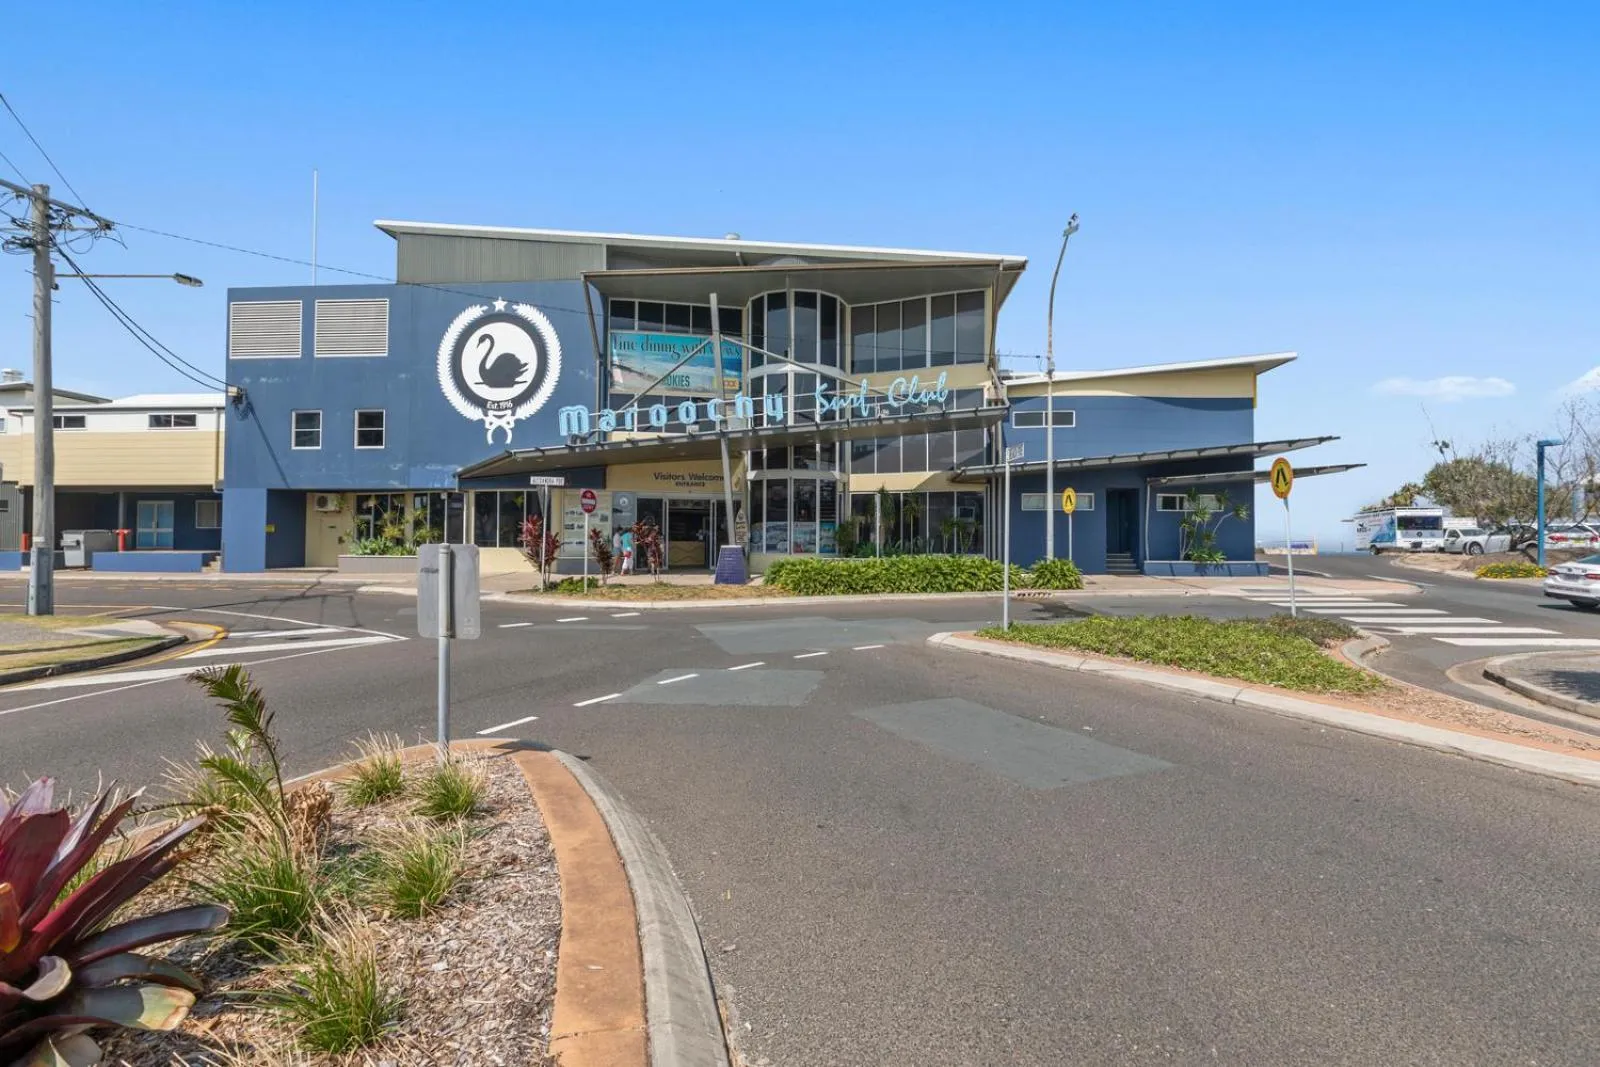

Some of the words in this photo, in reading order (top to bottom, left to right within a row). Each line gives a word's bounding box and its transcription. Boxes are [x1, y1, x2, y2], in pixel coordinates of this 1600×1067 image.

[640, 334, 681, 360] dining
[815, 378, 869, 416] Surf
[888, 371, 949, 407] Club
[653, 472, 686, 481] Visitors
[688, 472, 724, 481] Welcom
